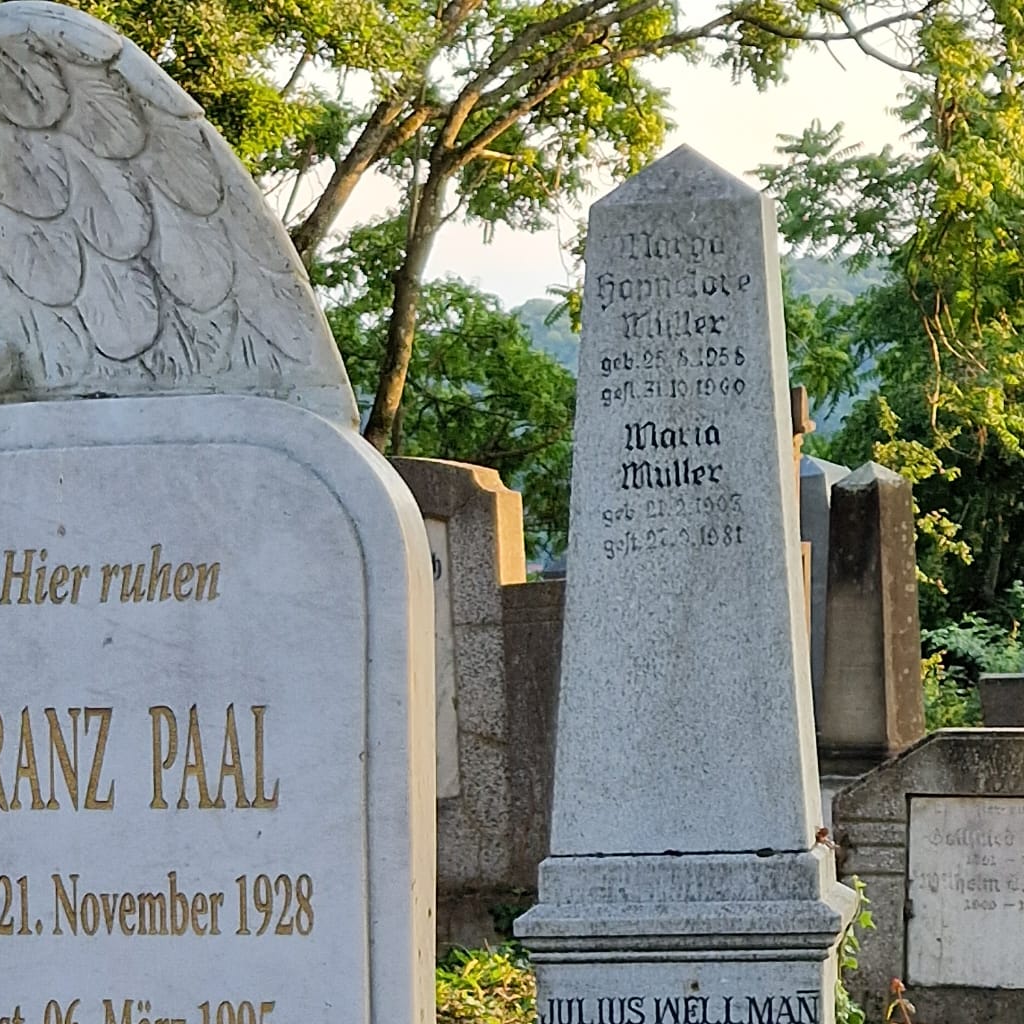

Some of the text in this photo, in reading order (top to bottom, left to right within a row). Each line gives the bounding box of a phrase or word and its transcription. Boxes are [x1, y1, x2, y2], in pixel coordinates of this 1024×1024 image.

[625, 421, 721, 451] Maria
[621, 457, 723, 490] Müller
[100, 544, 220, 603] ruhen
[149, 703, 279, 811] PAAL
[51, 871, 224, 937] November
[235, 874, 314, 937] 1928
